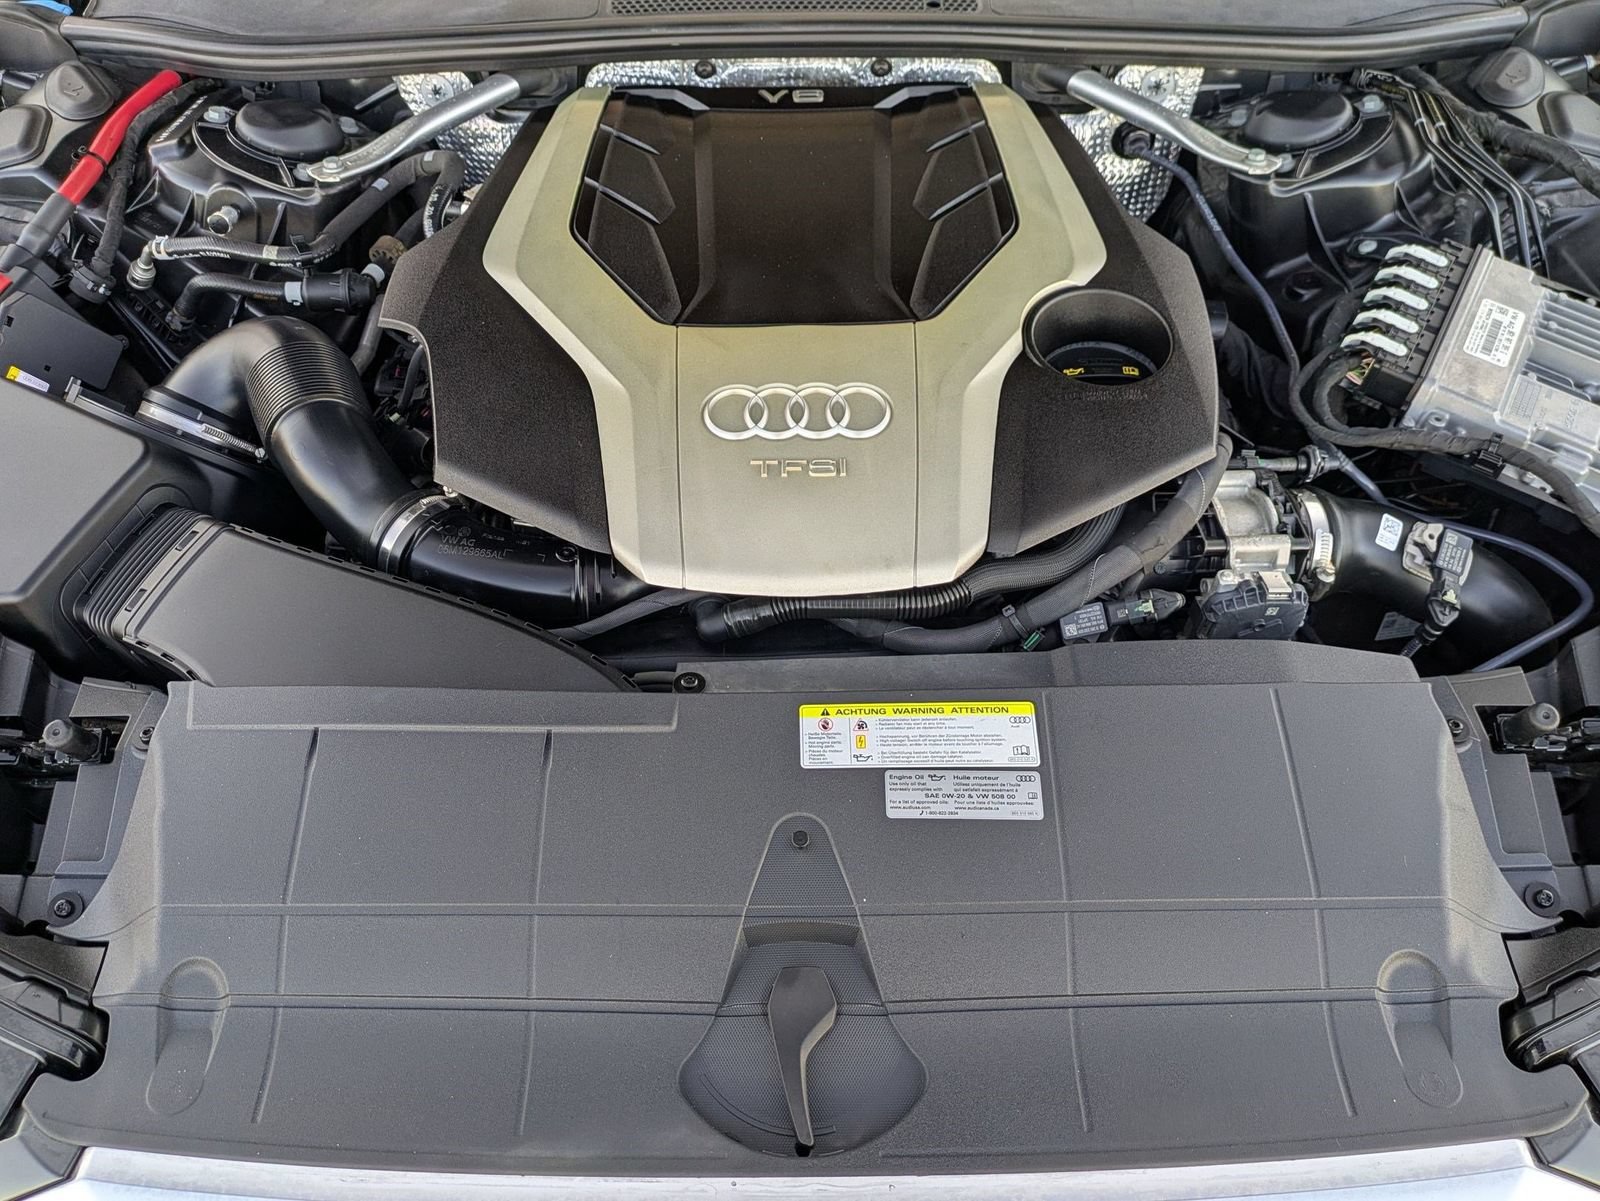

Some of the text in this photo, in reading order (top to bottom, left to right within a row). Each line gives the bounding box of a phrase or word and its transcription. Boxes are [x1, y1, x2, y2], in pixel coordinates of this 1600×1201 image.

[758, 89, 824, 104] V8
[750, 458, 848, 478] TFSI
[440, 534, 459, 546] VW
[460, 538, 476, 547] AG
[835, 706, 1009, 716] ACHTUNG WARNING ATTENTION
